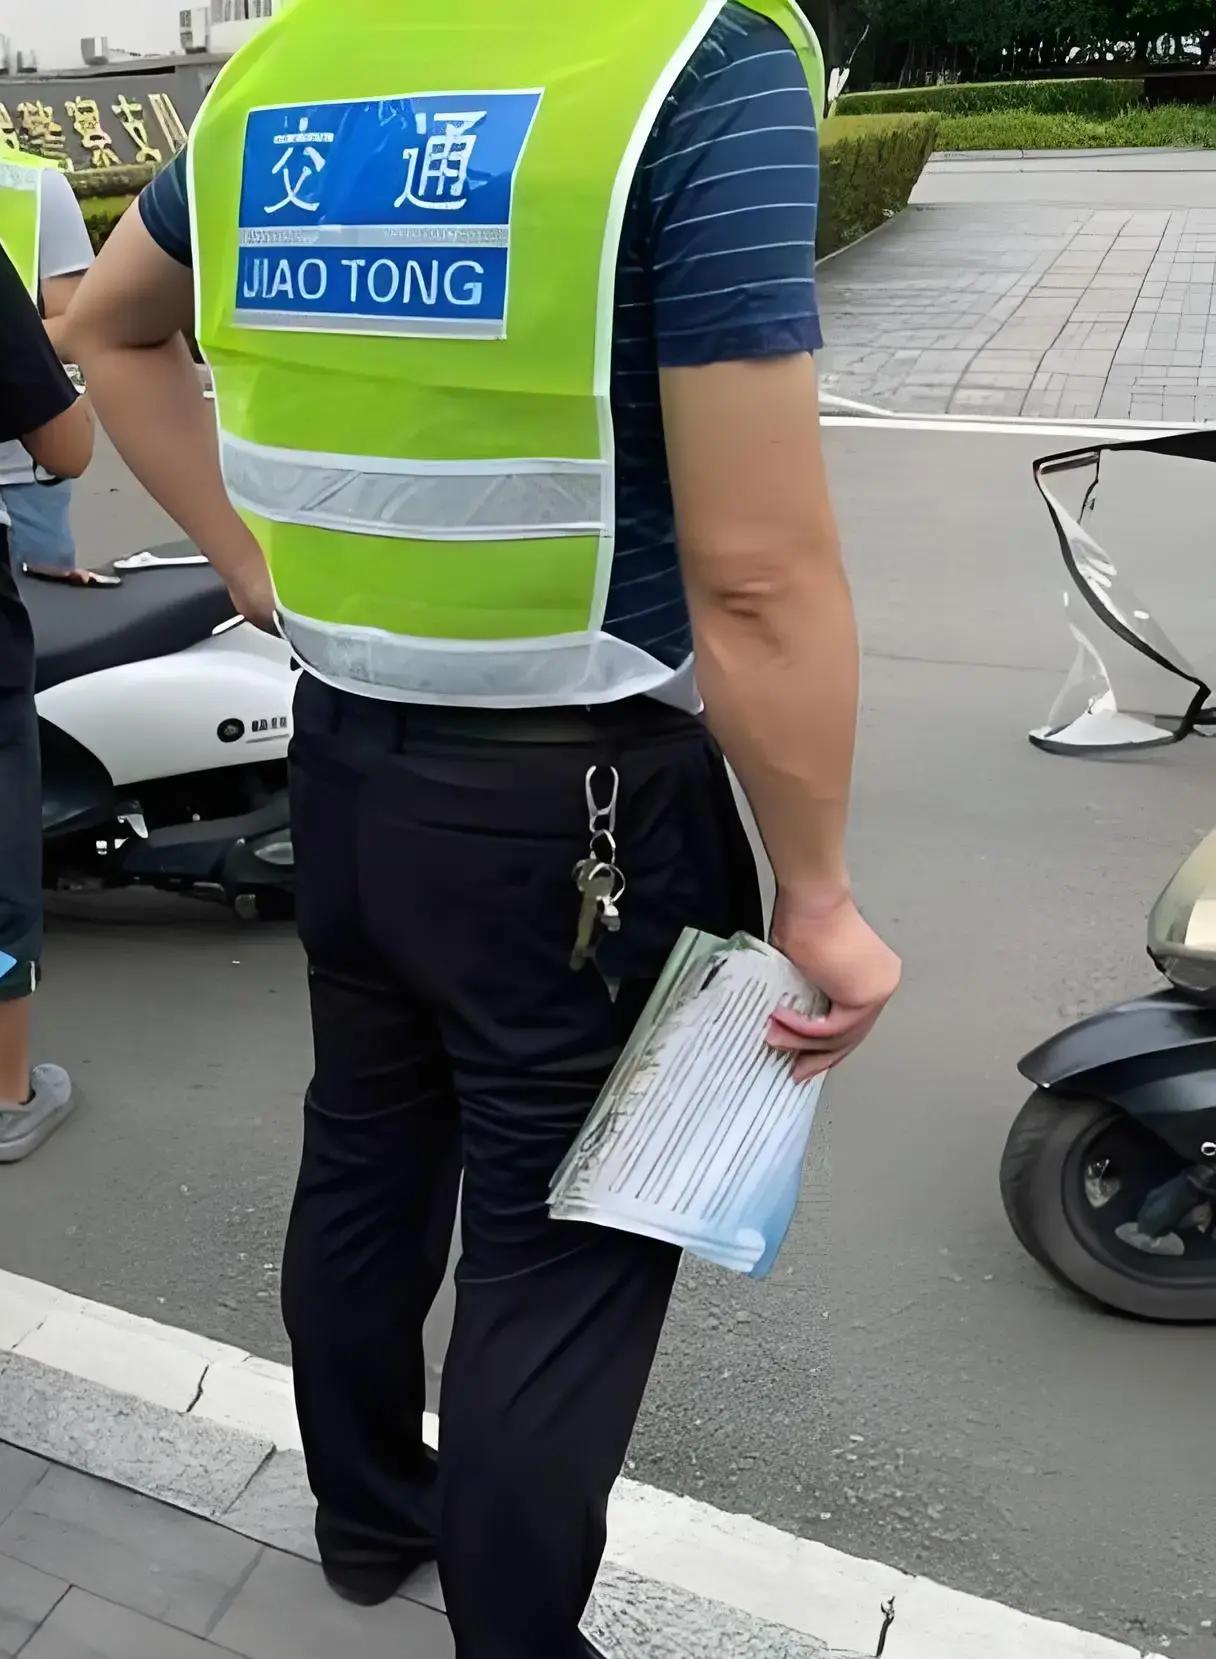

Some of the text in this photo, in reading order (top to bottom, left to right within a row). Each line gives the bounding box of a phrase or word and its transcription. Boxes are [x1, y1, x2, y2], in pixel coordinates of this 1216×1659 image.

[263, 110, 488, 214] 交通
[242, 257, 485, 306] JIAO TONG
